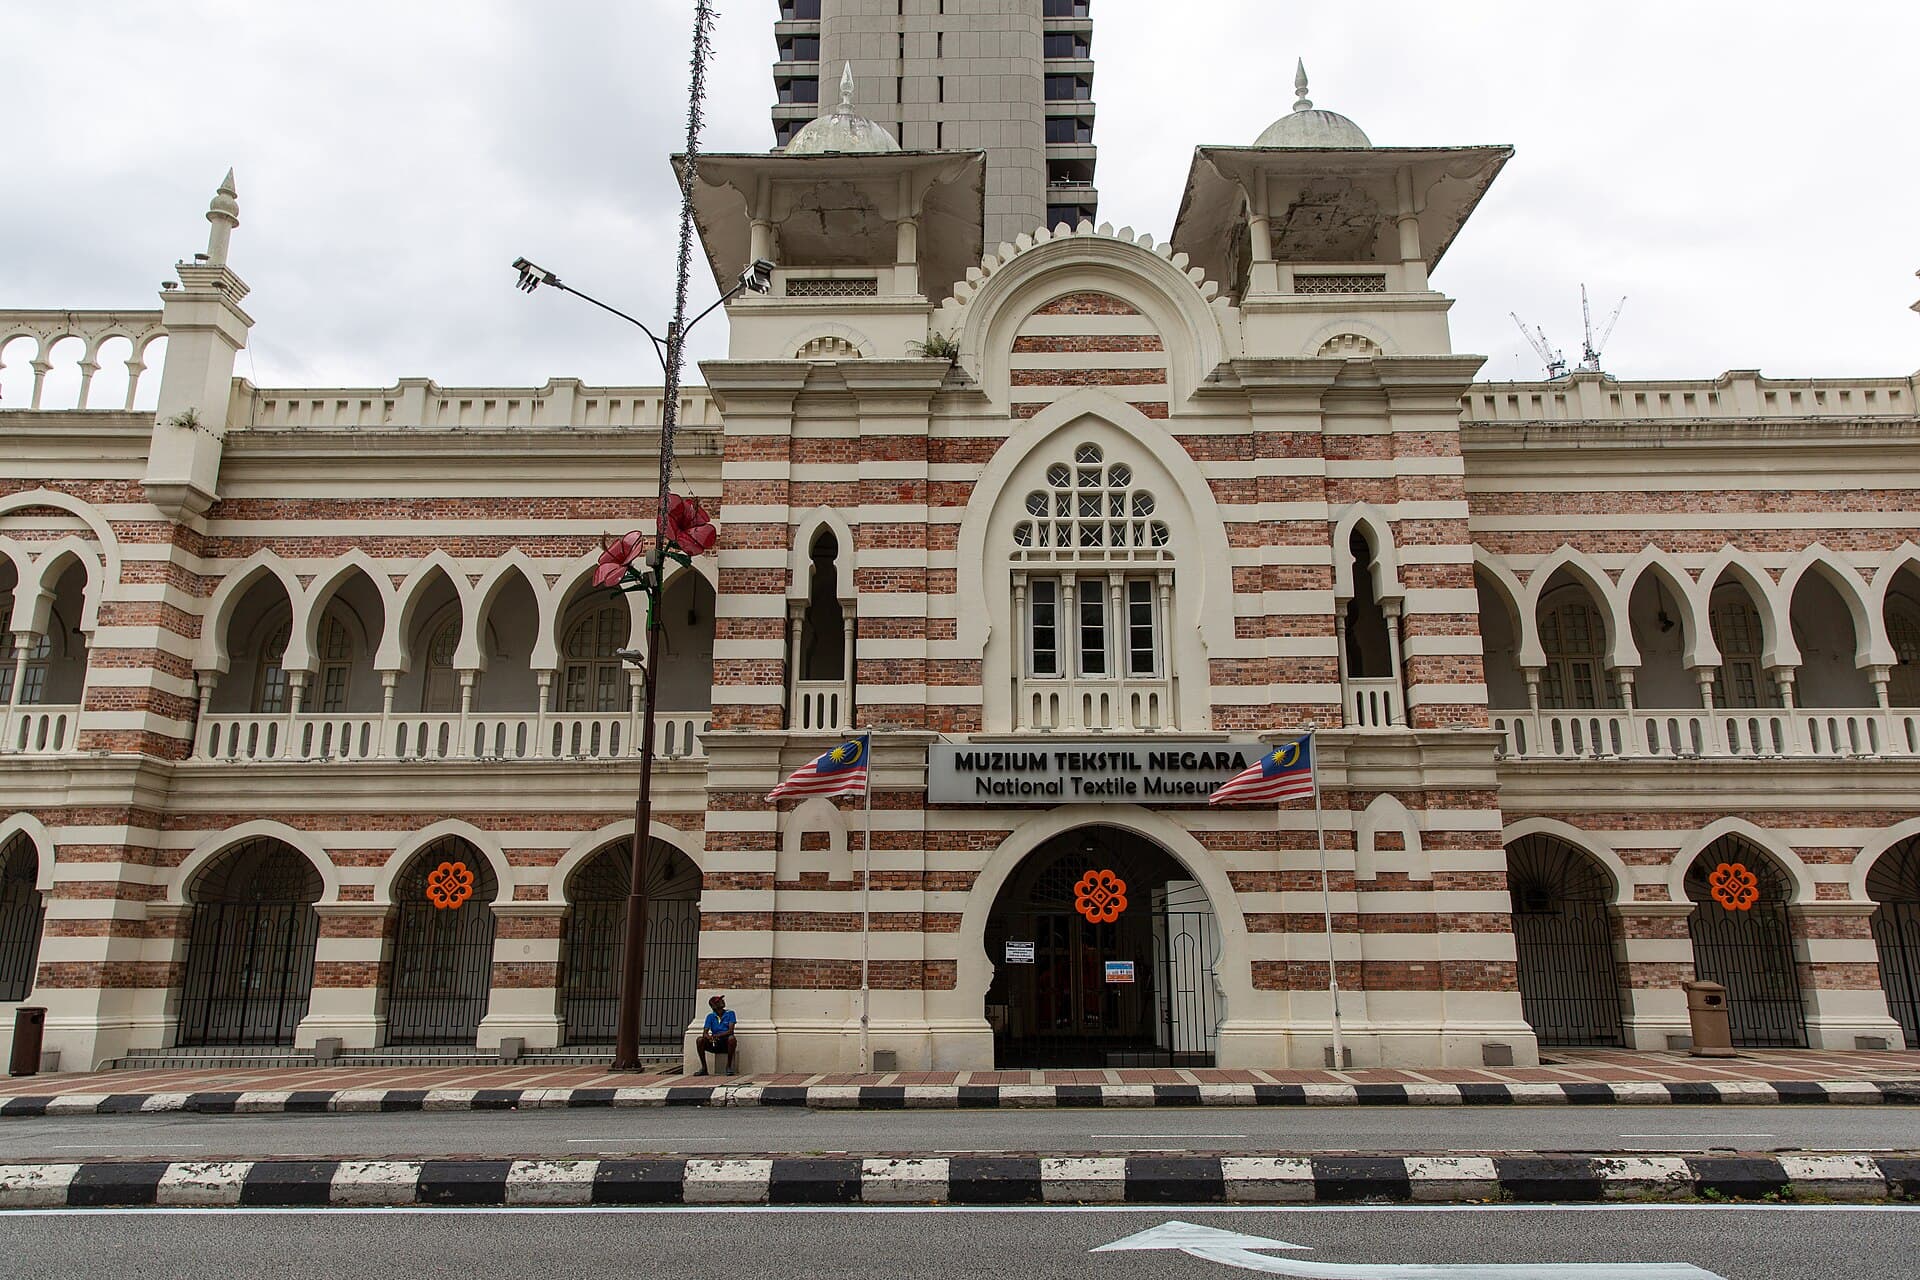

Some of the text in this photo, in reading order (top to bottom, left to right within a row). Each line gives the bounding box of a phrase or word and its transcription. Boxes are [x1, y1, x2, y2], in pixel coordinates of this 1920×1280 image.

[955, 751, 1248, 770] MUZIUM TEKSTIL NEGARA
[975, 777, 1063, 795] National
[1070, 777, 1137, 795] Textile
